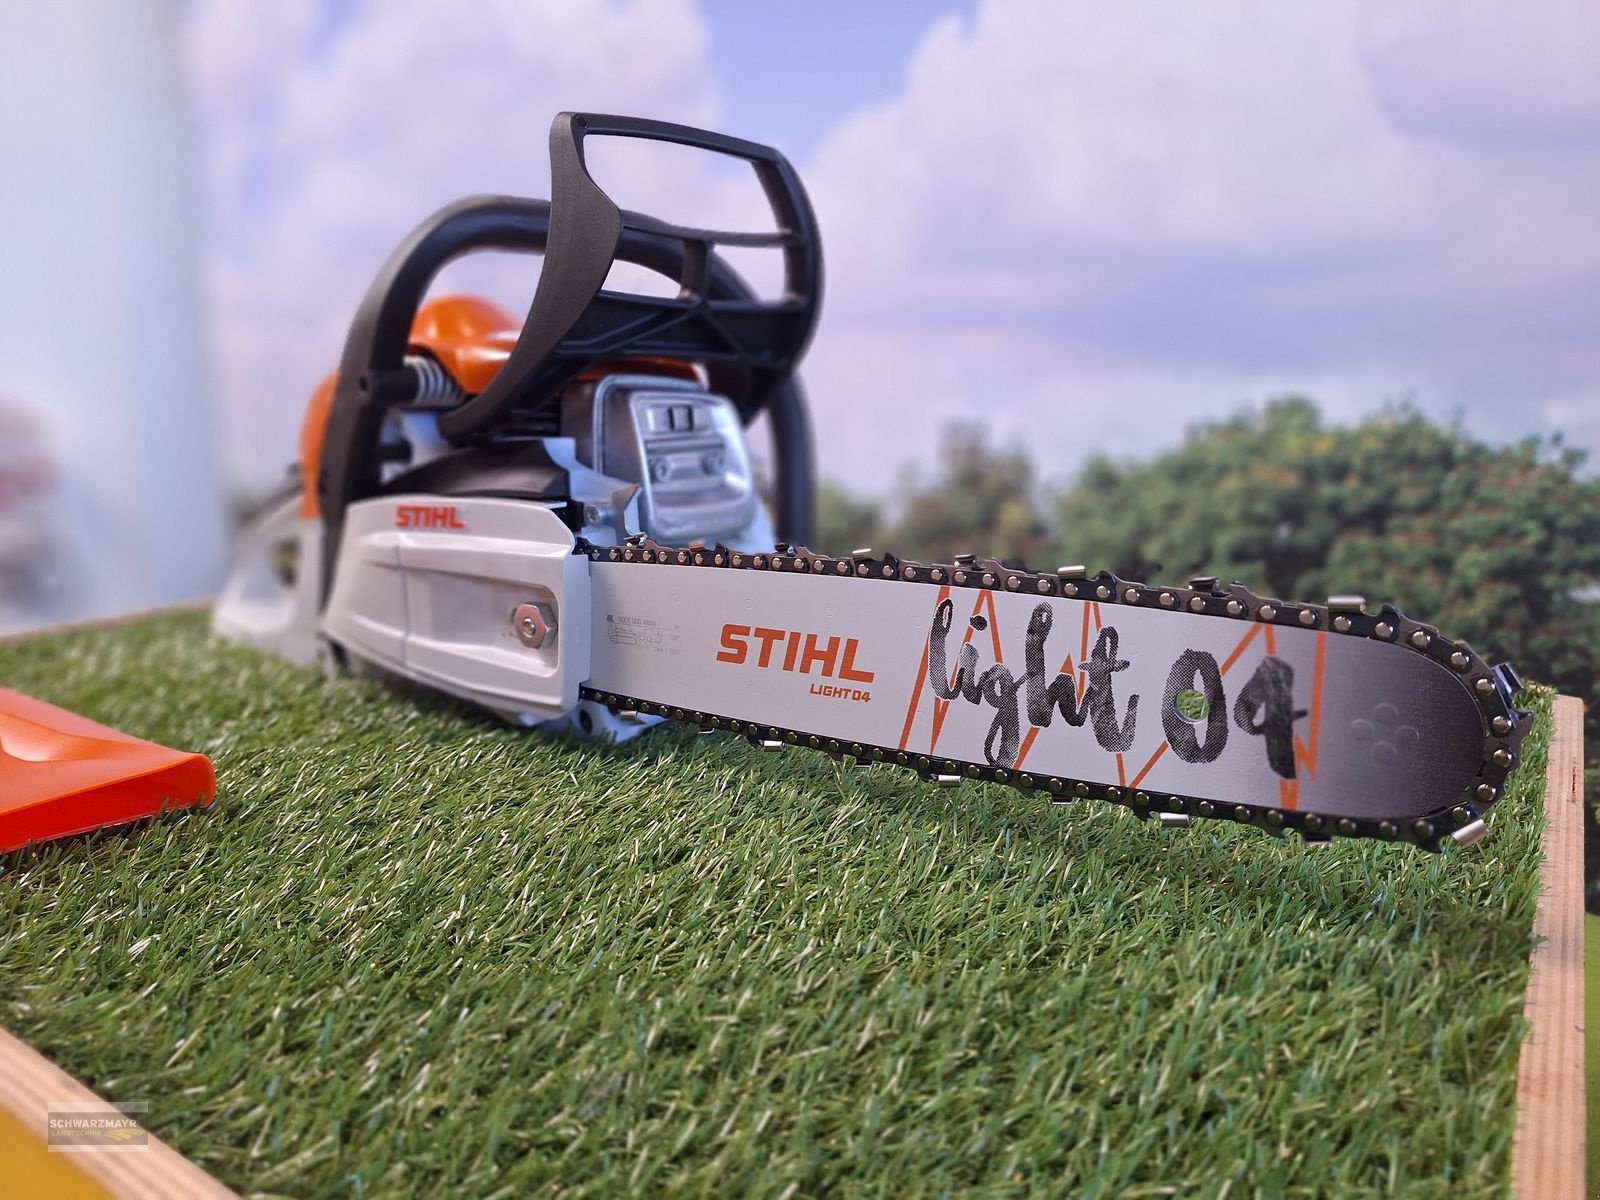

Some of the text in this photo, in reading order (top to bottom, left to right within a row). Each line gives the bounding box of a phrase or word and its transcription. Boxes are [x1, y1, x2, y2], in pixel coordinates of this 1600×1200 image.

[396, 505, 465, 528] STIHL
[716, 624, 875, 683] STIHL
[928, 597, 1139, 769] light
